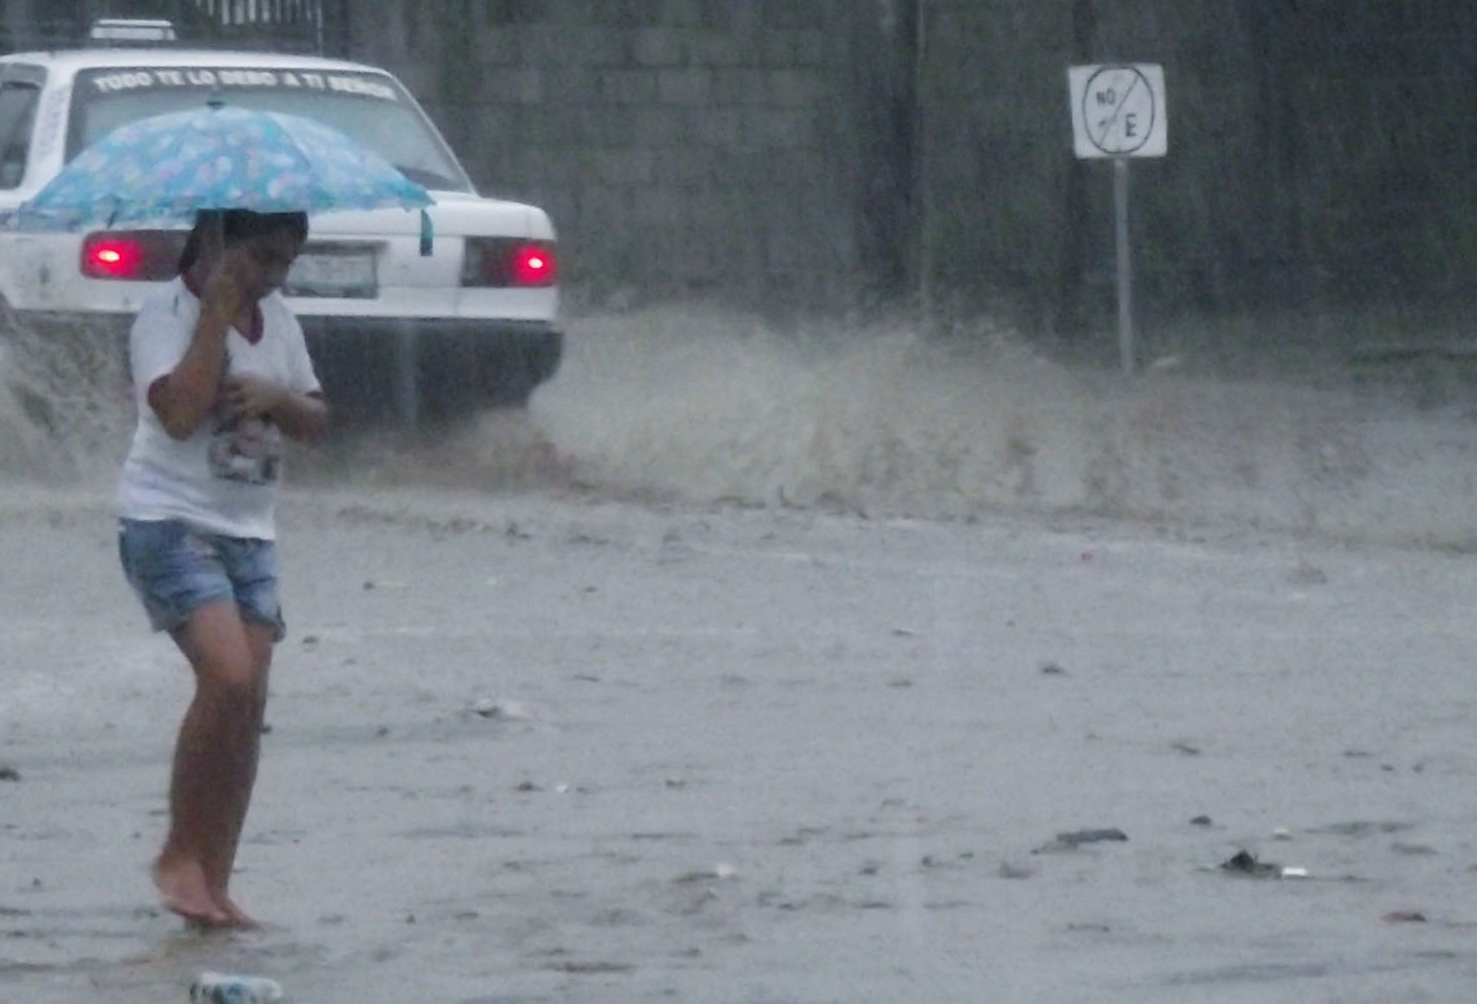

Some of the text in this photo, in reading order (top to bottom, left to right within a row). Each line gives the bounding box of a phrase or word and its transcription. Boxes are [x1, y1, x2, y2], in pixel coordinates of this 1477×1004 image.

[93, 71, 153, 93] TODO
[154, 70, 185, 85] TE
[186, 69, 217, 86] LO
[281, 72, 301, 87] A
[1096, 88, 1116, 105] NO
[1125, 113, 1136, 137] E
